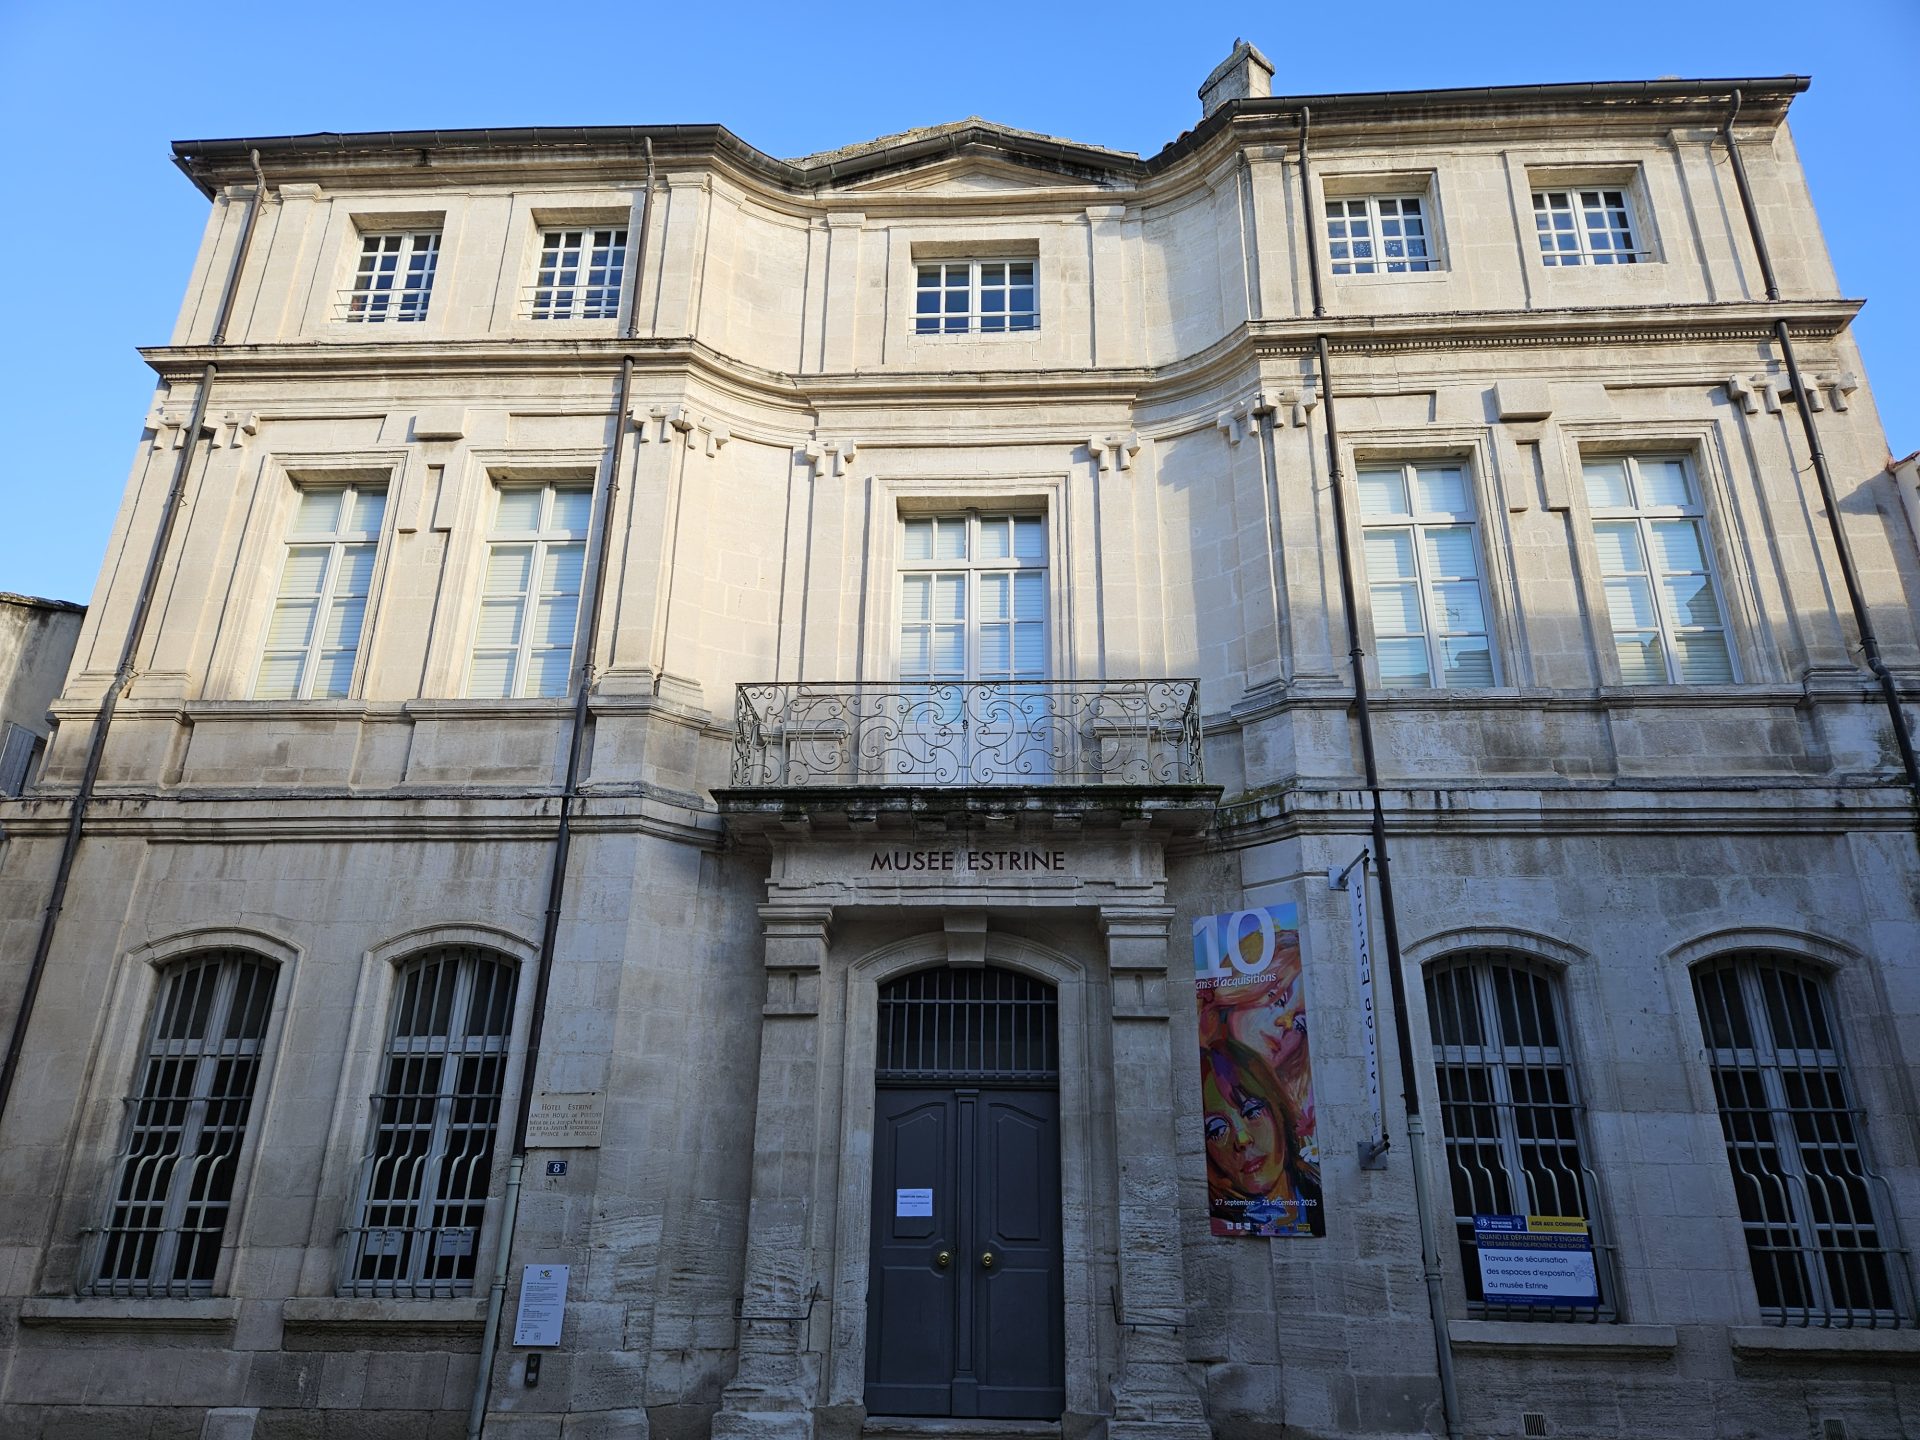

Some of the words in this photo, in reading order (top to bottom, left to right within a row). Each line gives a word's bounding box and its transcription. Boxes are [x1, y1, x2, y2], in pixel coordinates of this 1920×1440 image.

[870, 851, 954, 871] MUSEE
[967, 851, 1065, 871] ESTRINE
[1356, 884, 1370, 986] Estrine
[1192, 907, 1276, 979] 10
[1196, 980, 1212, 990] ans
[1213, 973, 1277, 988] d'acquisitions
[553, 1163, 561, 1173] 8
[1223, 1199, 1255, 1207] septembre
[1270, 1199, 1300, 1207] décembre
[1301, 1199, 1318, 1207] 2025
[1484, 1254, 1513, 1263] Travaux
[1513, 1254, 1524, 1263] de
[1525, 1255, 1568, 1264] sécurisation
[1501, 1269, 1531, 1277] espaces
[1532, 1269, 1576, 1278] d'exposition
[1499, 1281, 1524, 1289] musée
[1525, 1282, 1549, 1290] Estrine
